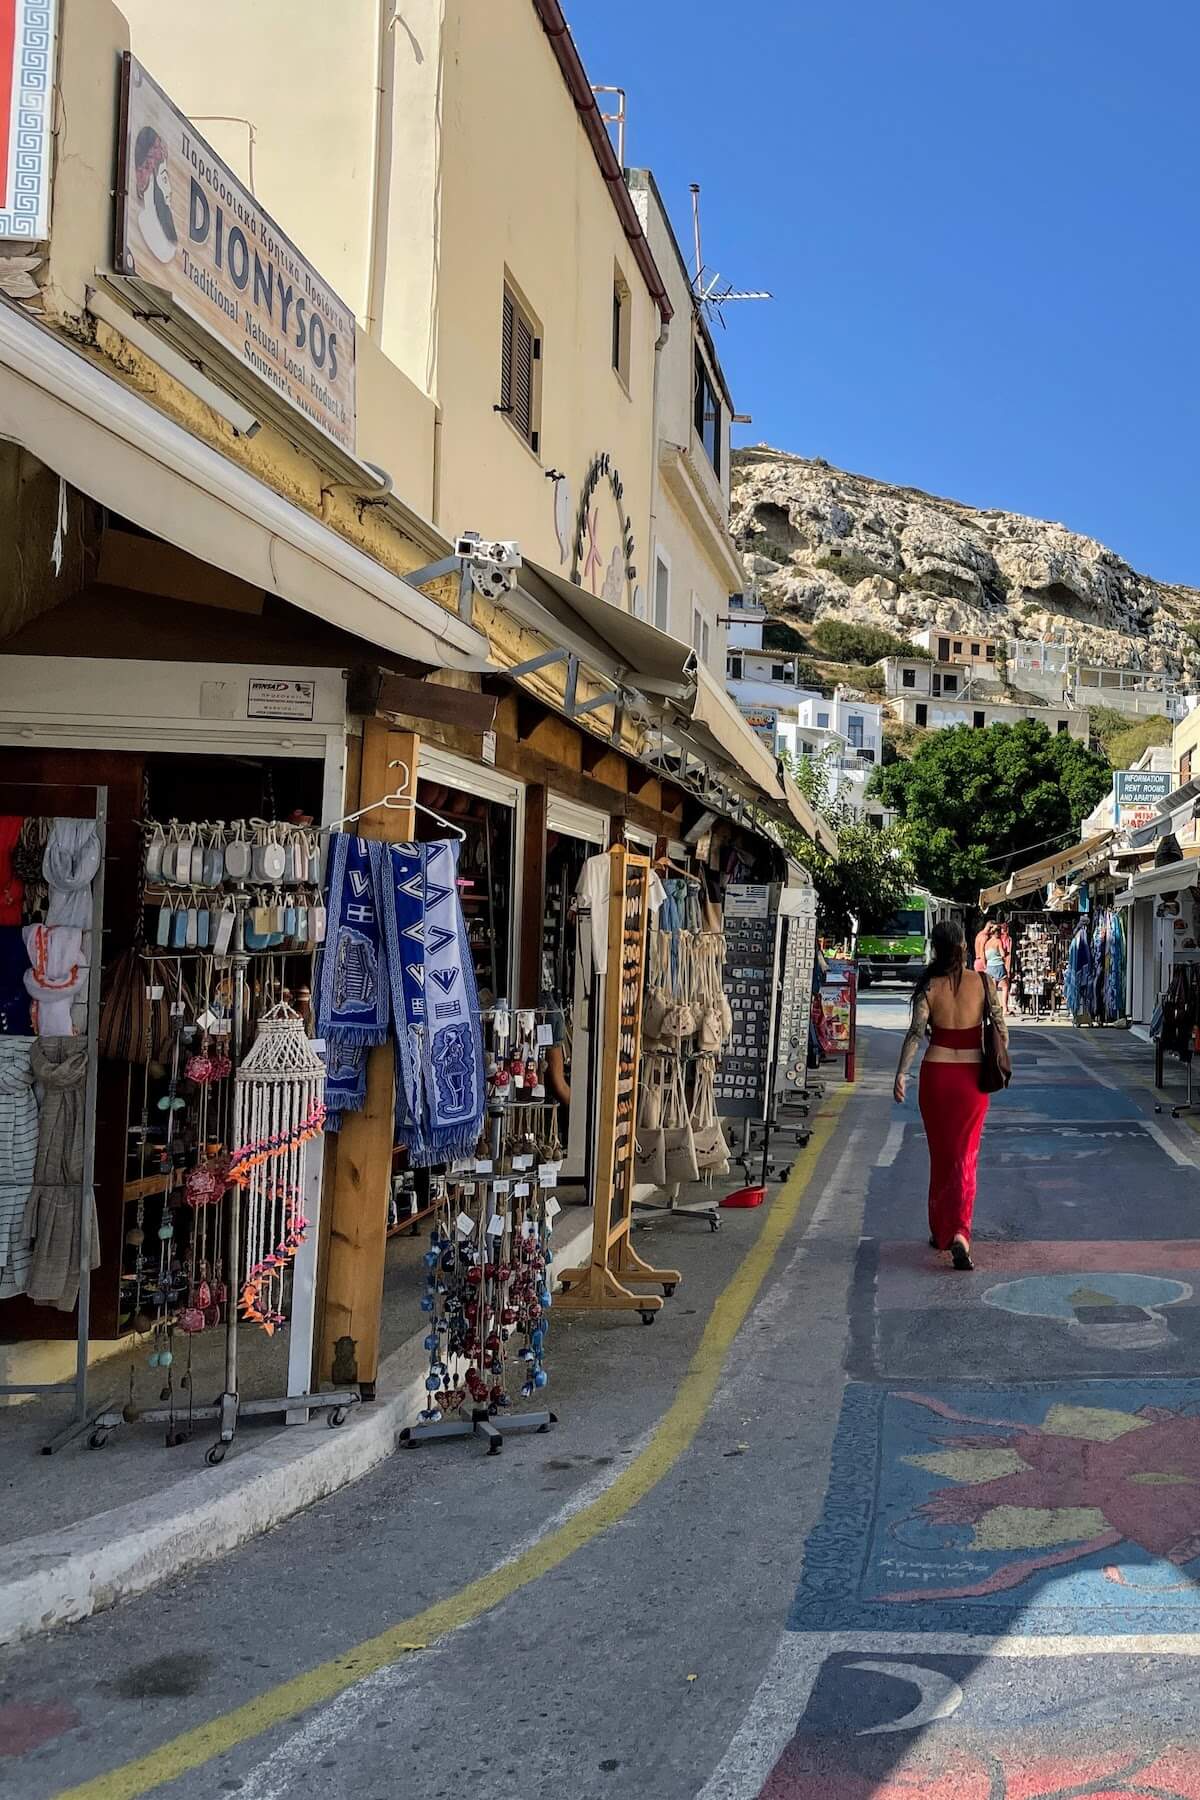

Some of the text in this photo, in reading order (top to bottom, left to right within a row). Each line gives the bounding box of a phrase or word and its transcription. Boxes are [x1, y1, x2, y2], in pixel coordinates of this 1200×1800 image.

[182, 133, 256, 235] Παραδοσιακά
[189, 176, 338, 381] DIONYSOS
[182, 249, 239, 324] Traditional
[245, 310, 279, 361] Natural
[284, 348, 306, 386] Local
[1120, 793, 1133, 801] AND
[1124, 774, 1164, 783] INFORMATION
[1124, 784, 1166, 793] RENT ROOMS
